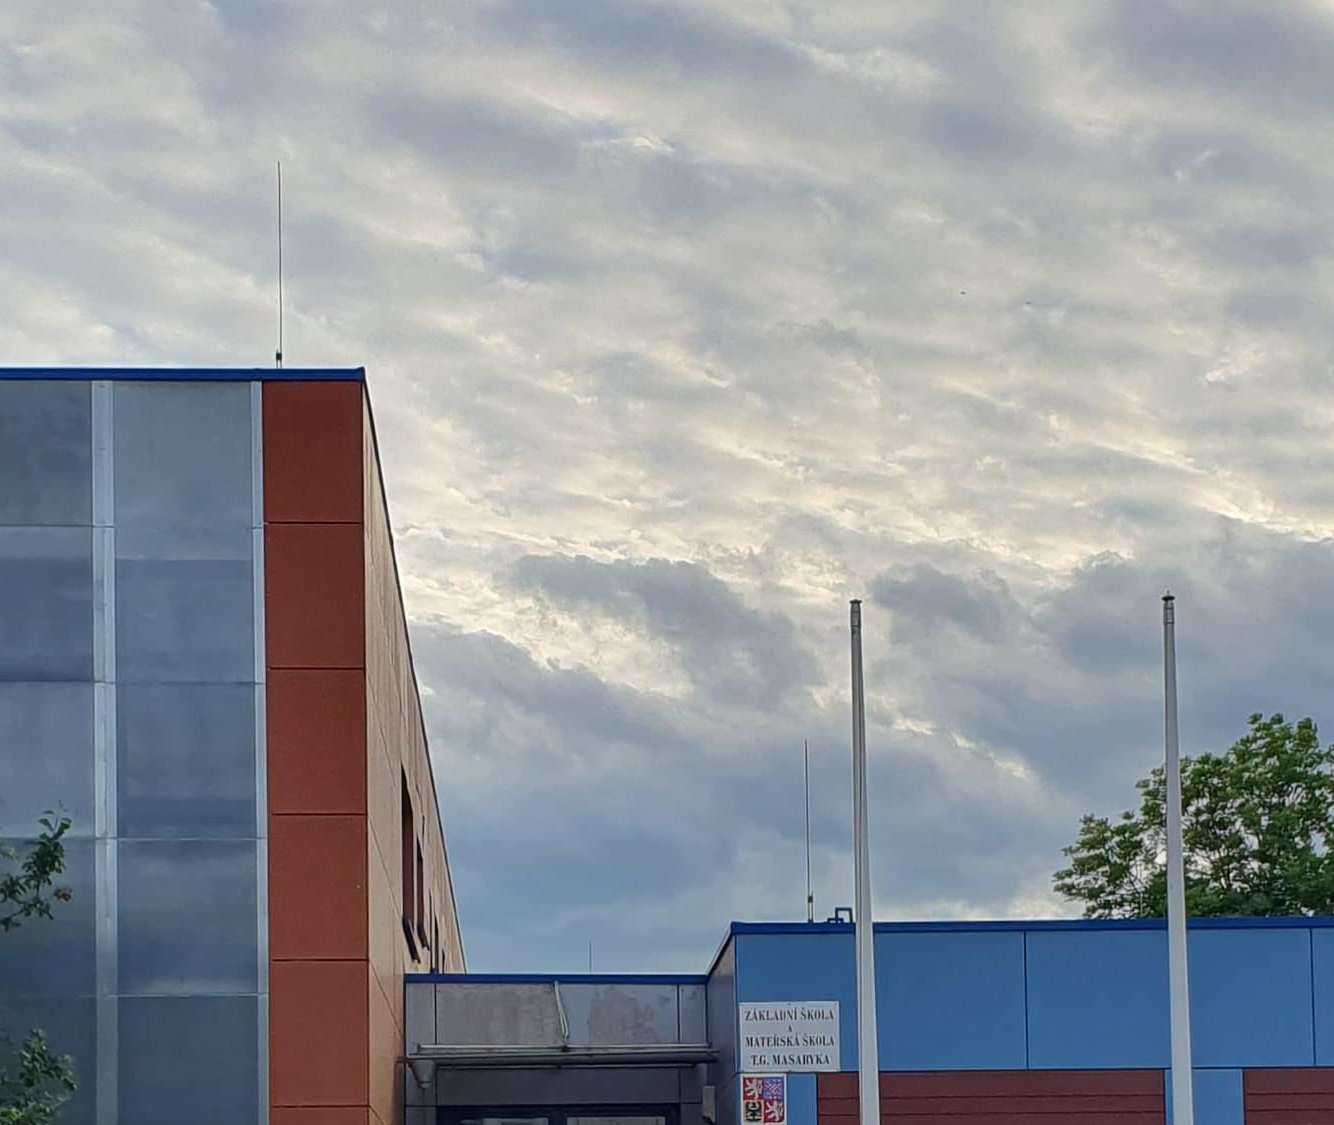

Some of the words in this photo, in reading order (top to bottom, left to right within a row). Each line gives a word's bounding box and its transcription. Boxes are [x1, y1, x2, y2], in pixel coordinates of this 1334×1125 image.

[745, 1007, 797, 1021] ZÁKLADNÍ
[800, 1007, 834, 1021] ŠKOLA
[787, 1024, 793, 1032] A
[746, 1034, 800, 1047] MATEŘSKÁ
[802, 1032, 835, 1046] ŠKOLA
[750, 1055, 769, 1065] T.G.
[772, 1054, 830, 1065] MASARYKA
